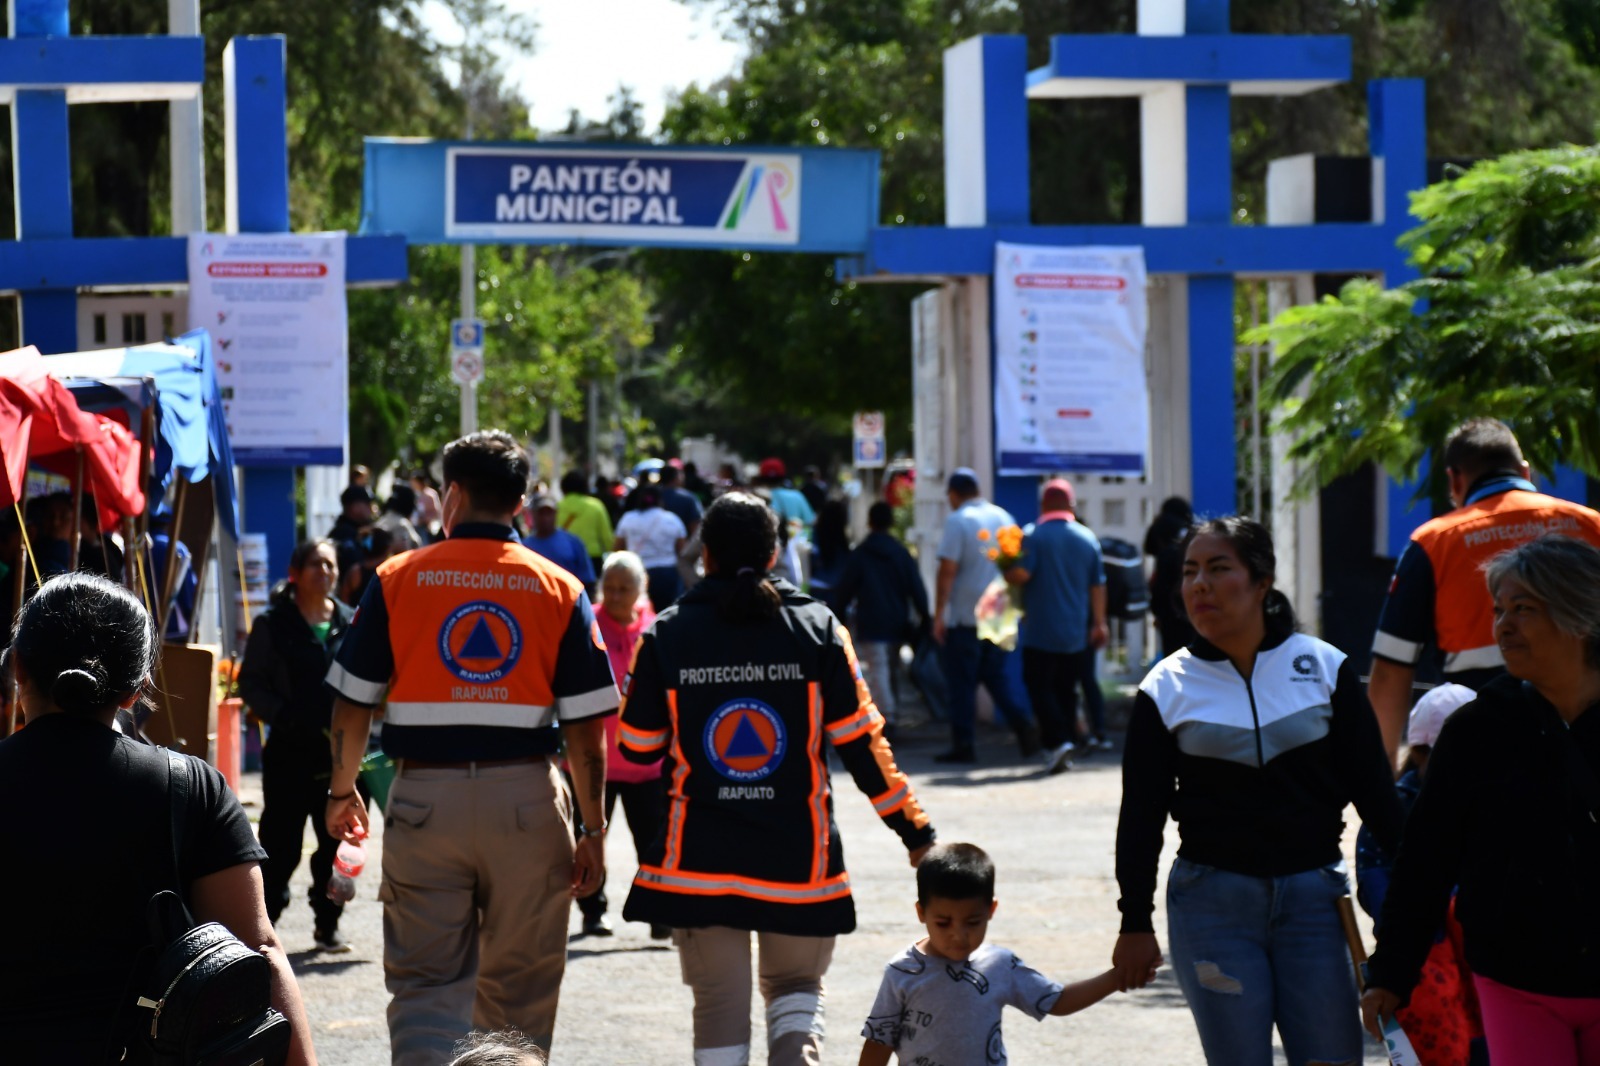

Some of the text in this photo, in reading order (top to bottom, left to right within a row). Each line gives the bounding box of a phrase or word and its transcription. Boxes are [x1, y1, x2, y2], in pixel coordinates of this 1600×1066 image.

[510, 160, 671, 194] PANTEÓN
[496, 195, 683, 224] MUNICIPAL
[417, 570, 543, 593] PROTECCIÓN CIVIL
[459, 669, 502, 680] IRAPUATO
[680, 662, 804, 685] PROTECCIÓN CIVIL
[451, 686, 509, 701] IRAPUATO
[728, 766, 770, 779] IRAPUATO
[718, 787, 775, 800] IRAPUATO
[916, 1010, 934, 1028] TO
